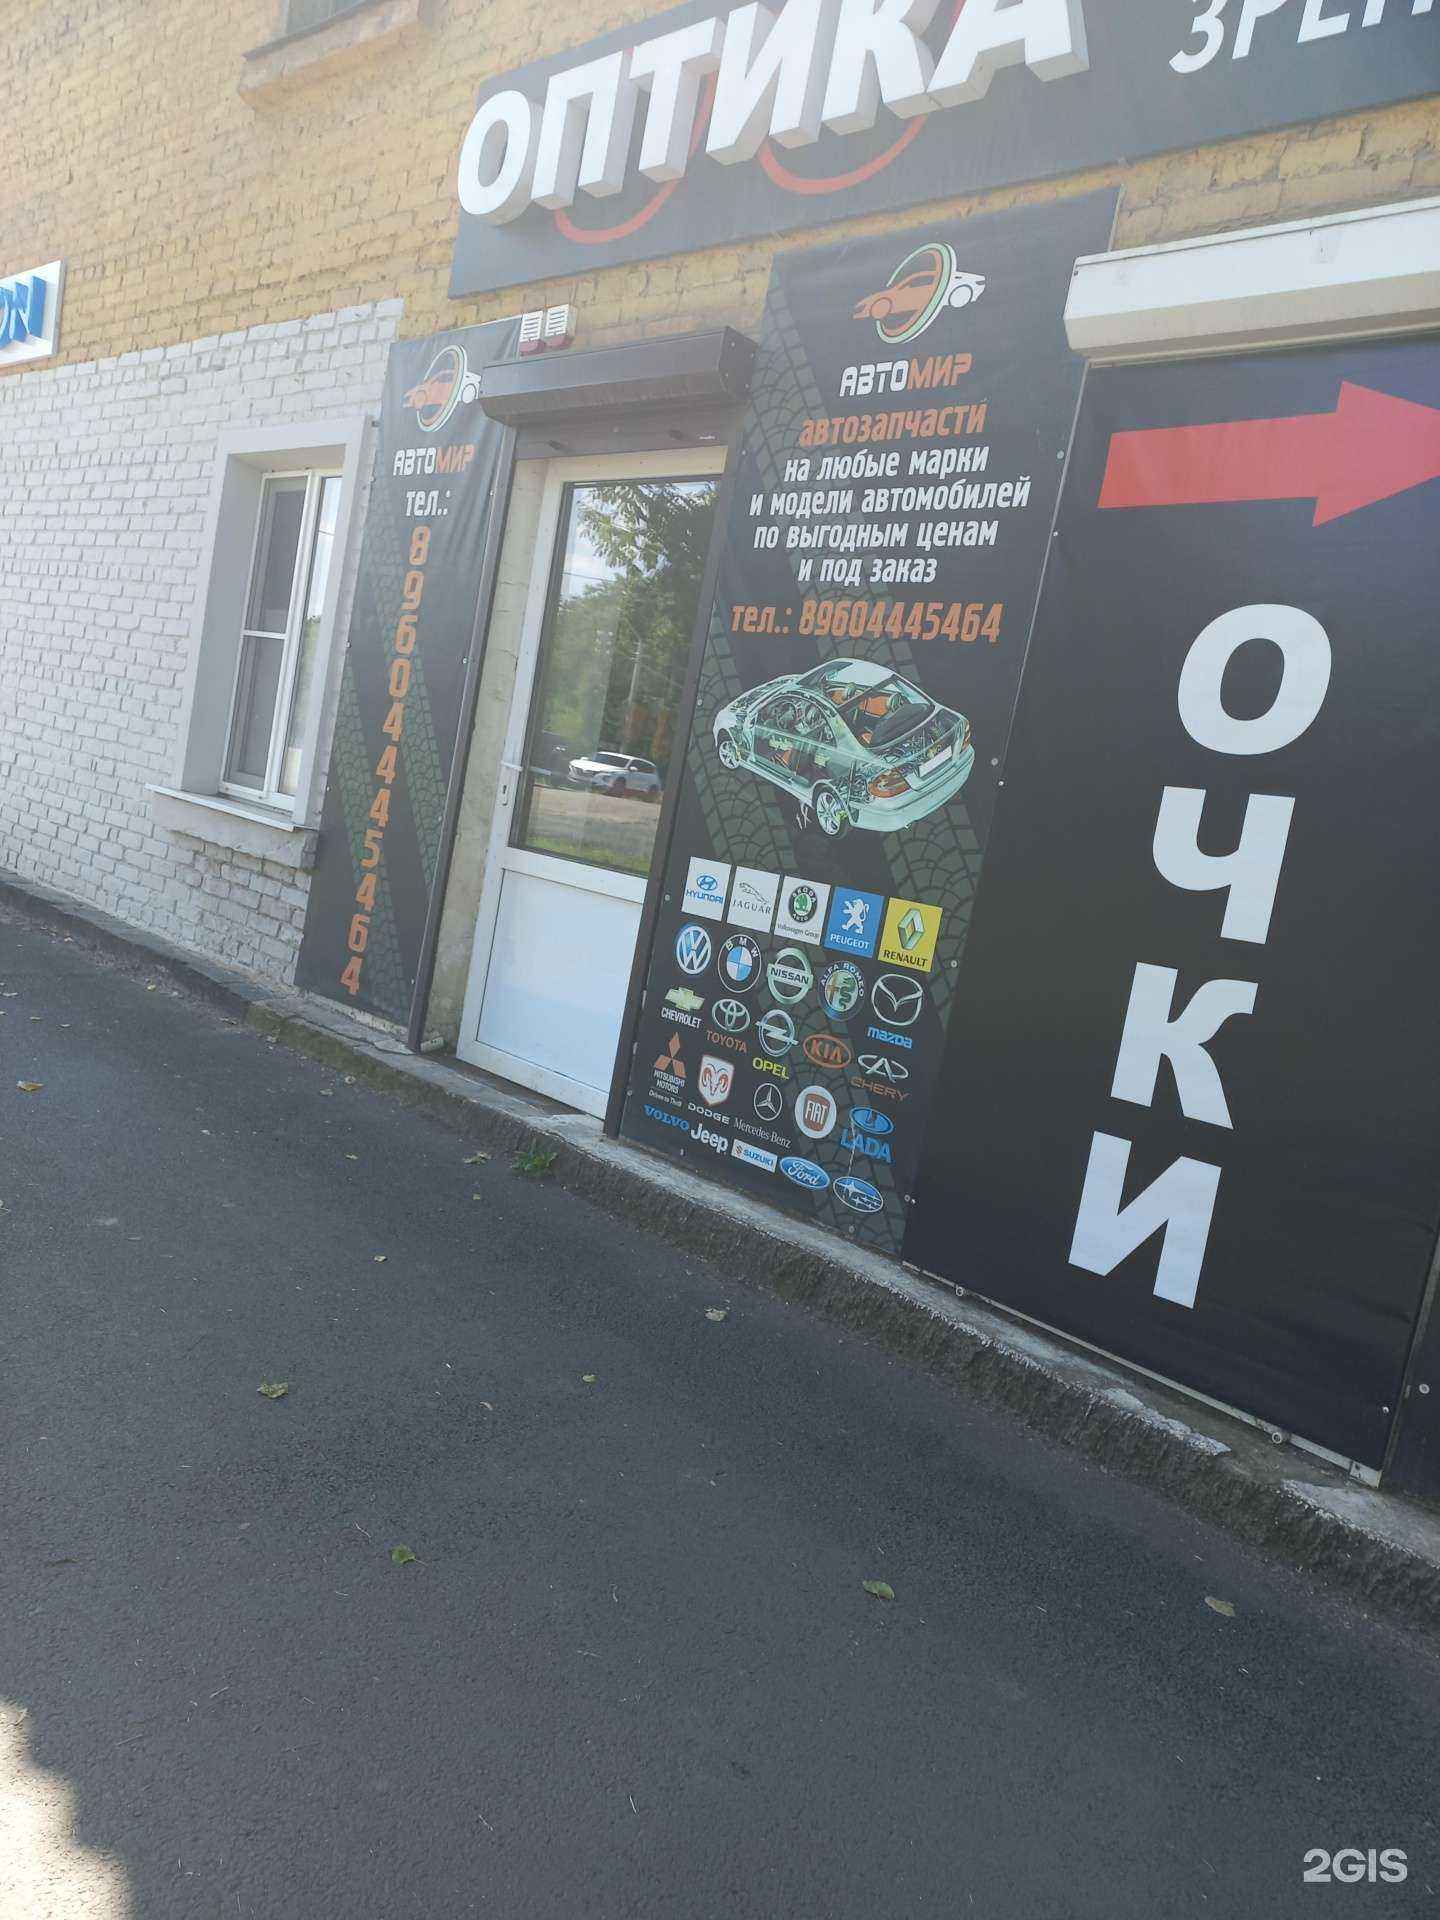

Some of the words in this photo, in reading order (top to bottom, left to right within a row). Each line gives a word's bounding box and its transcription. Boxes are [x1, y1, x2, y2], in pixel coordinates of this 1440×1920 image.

[457, 0, 1086, 222] ОПТИКА
[838, 352, 973, 397] АВТОМИР
[799, 401, 989, 448] автозапчасти
[392, 443, 476, 477] АВТОМИР
[784, 457, 809, 482] на
[815, 448, 900, 482] любые
[908, 446, 990, 480] марки
[749, 493, 764, 516] и
[769, 489, 853, 519] модели
[861, 476, 1032, 514] автомобилей
[753, 524, 779, 549] по
[785, 520, 909, 552] выгодным
[916, 519, 999, 551] ценам
[797, 558, 813, 582] и
[819, 558, 864, 587] под
[869, 557, 938, 584] заказ
[798, 599, 1004, 644] 89604445464
[685, 889, 725, 905] HYUNDAI
[731, 899, 771, 915] JAGUAR
[829, 932, 871, 951] PEUGEOT
[882, 949, 929, 968] RENAULT
[1068, 602, 1333, 1310] ОЧКИ
[770, 966, 809, 984] NISSAN
[661, 1006, 703, 1029] CHEVROLET
[706, 1029, 748, 1053] TOYOTA
[811, 1038, 844, 1064] KIA
[752, 1057, 790, 1080] OPEL
[849, 1076, 911, 1101] CHERY
[643, 1103, 690, 1132] VOLVO
[687, 1102, 731, 1125] DODGE
[804, 1101, 829, 1126] FIAT
[690, 1122, 729, 1155] Jeep
[840, 1128, 894, 1164] LADA
[743, 1148, 775, 1167] SUZUKI
[788, 1159, 821, 1187] Ford
